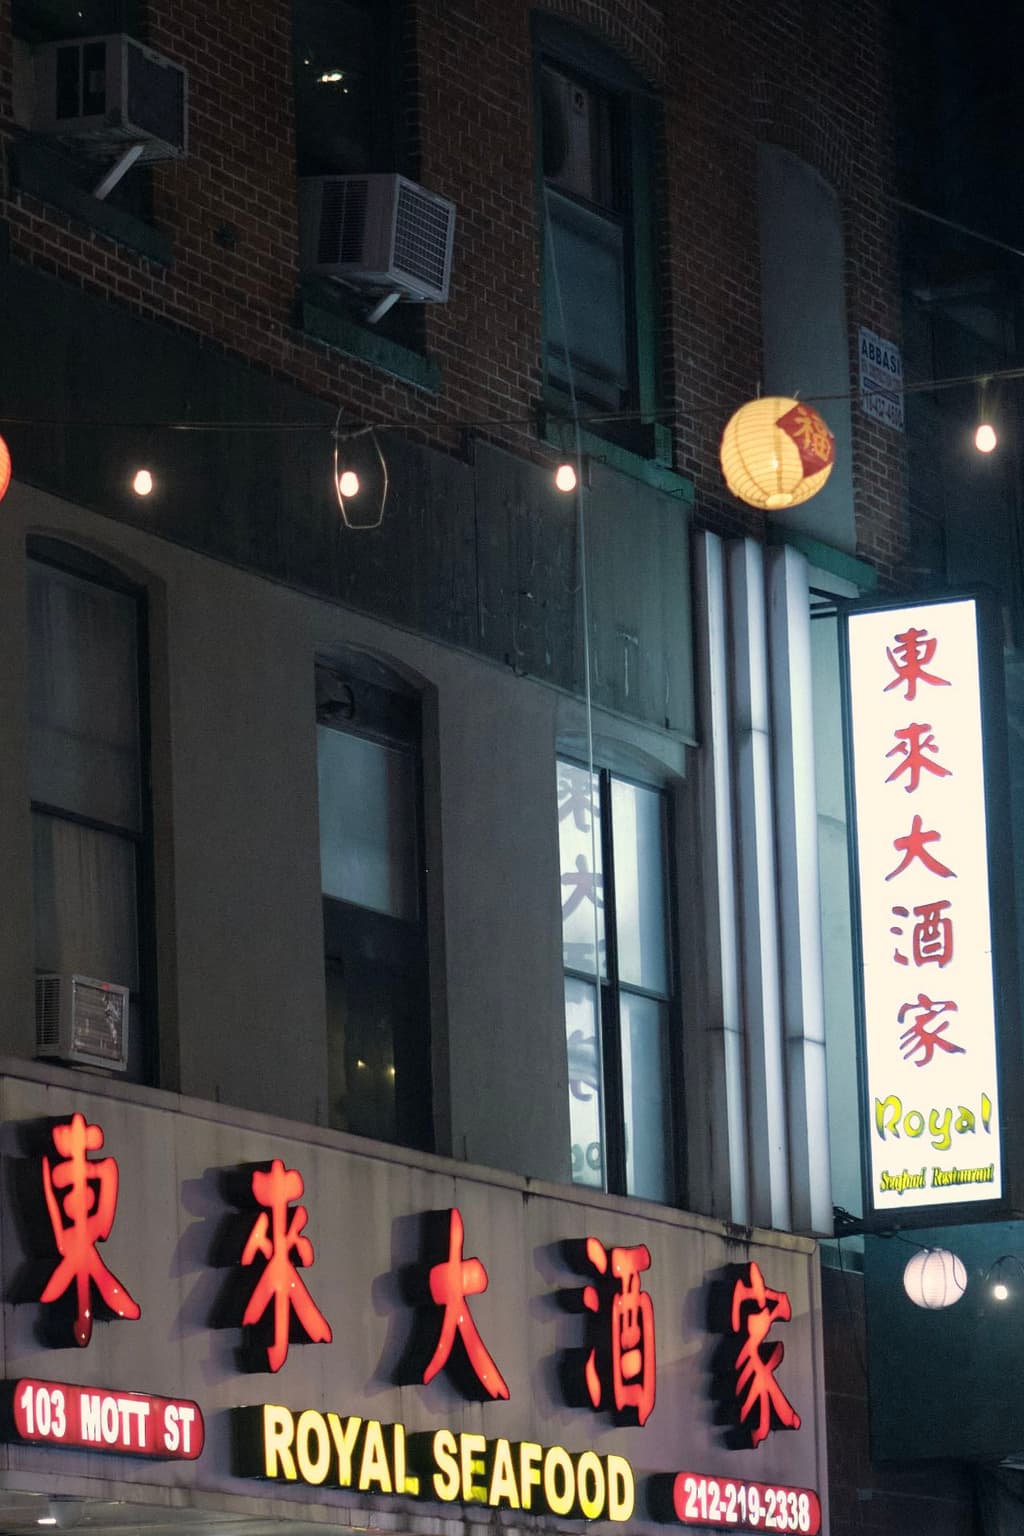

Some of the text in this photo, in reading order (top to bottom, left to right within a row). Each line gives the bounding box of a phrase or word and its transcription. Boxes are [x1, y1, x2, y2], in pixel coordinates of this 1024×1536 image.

[883, 628, 967, 1067] 東來大酒家
[875, 1092, 992, 1150] Royal
[880, 1163, 994, 1195] Seafood Restaurant
[40, 1112, 801, 1449] 東來大酒家
[21, 1385, 195, 1453] 103 MOTT ST
[264, 1404, 636, 1522] ROYAL SEAFOOD
[685, 1476, 810, 1531] 212-219-2338
